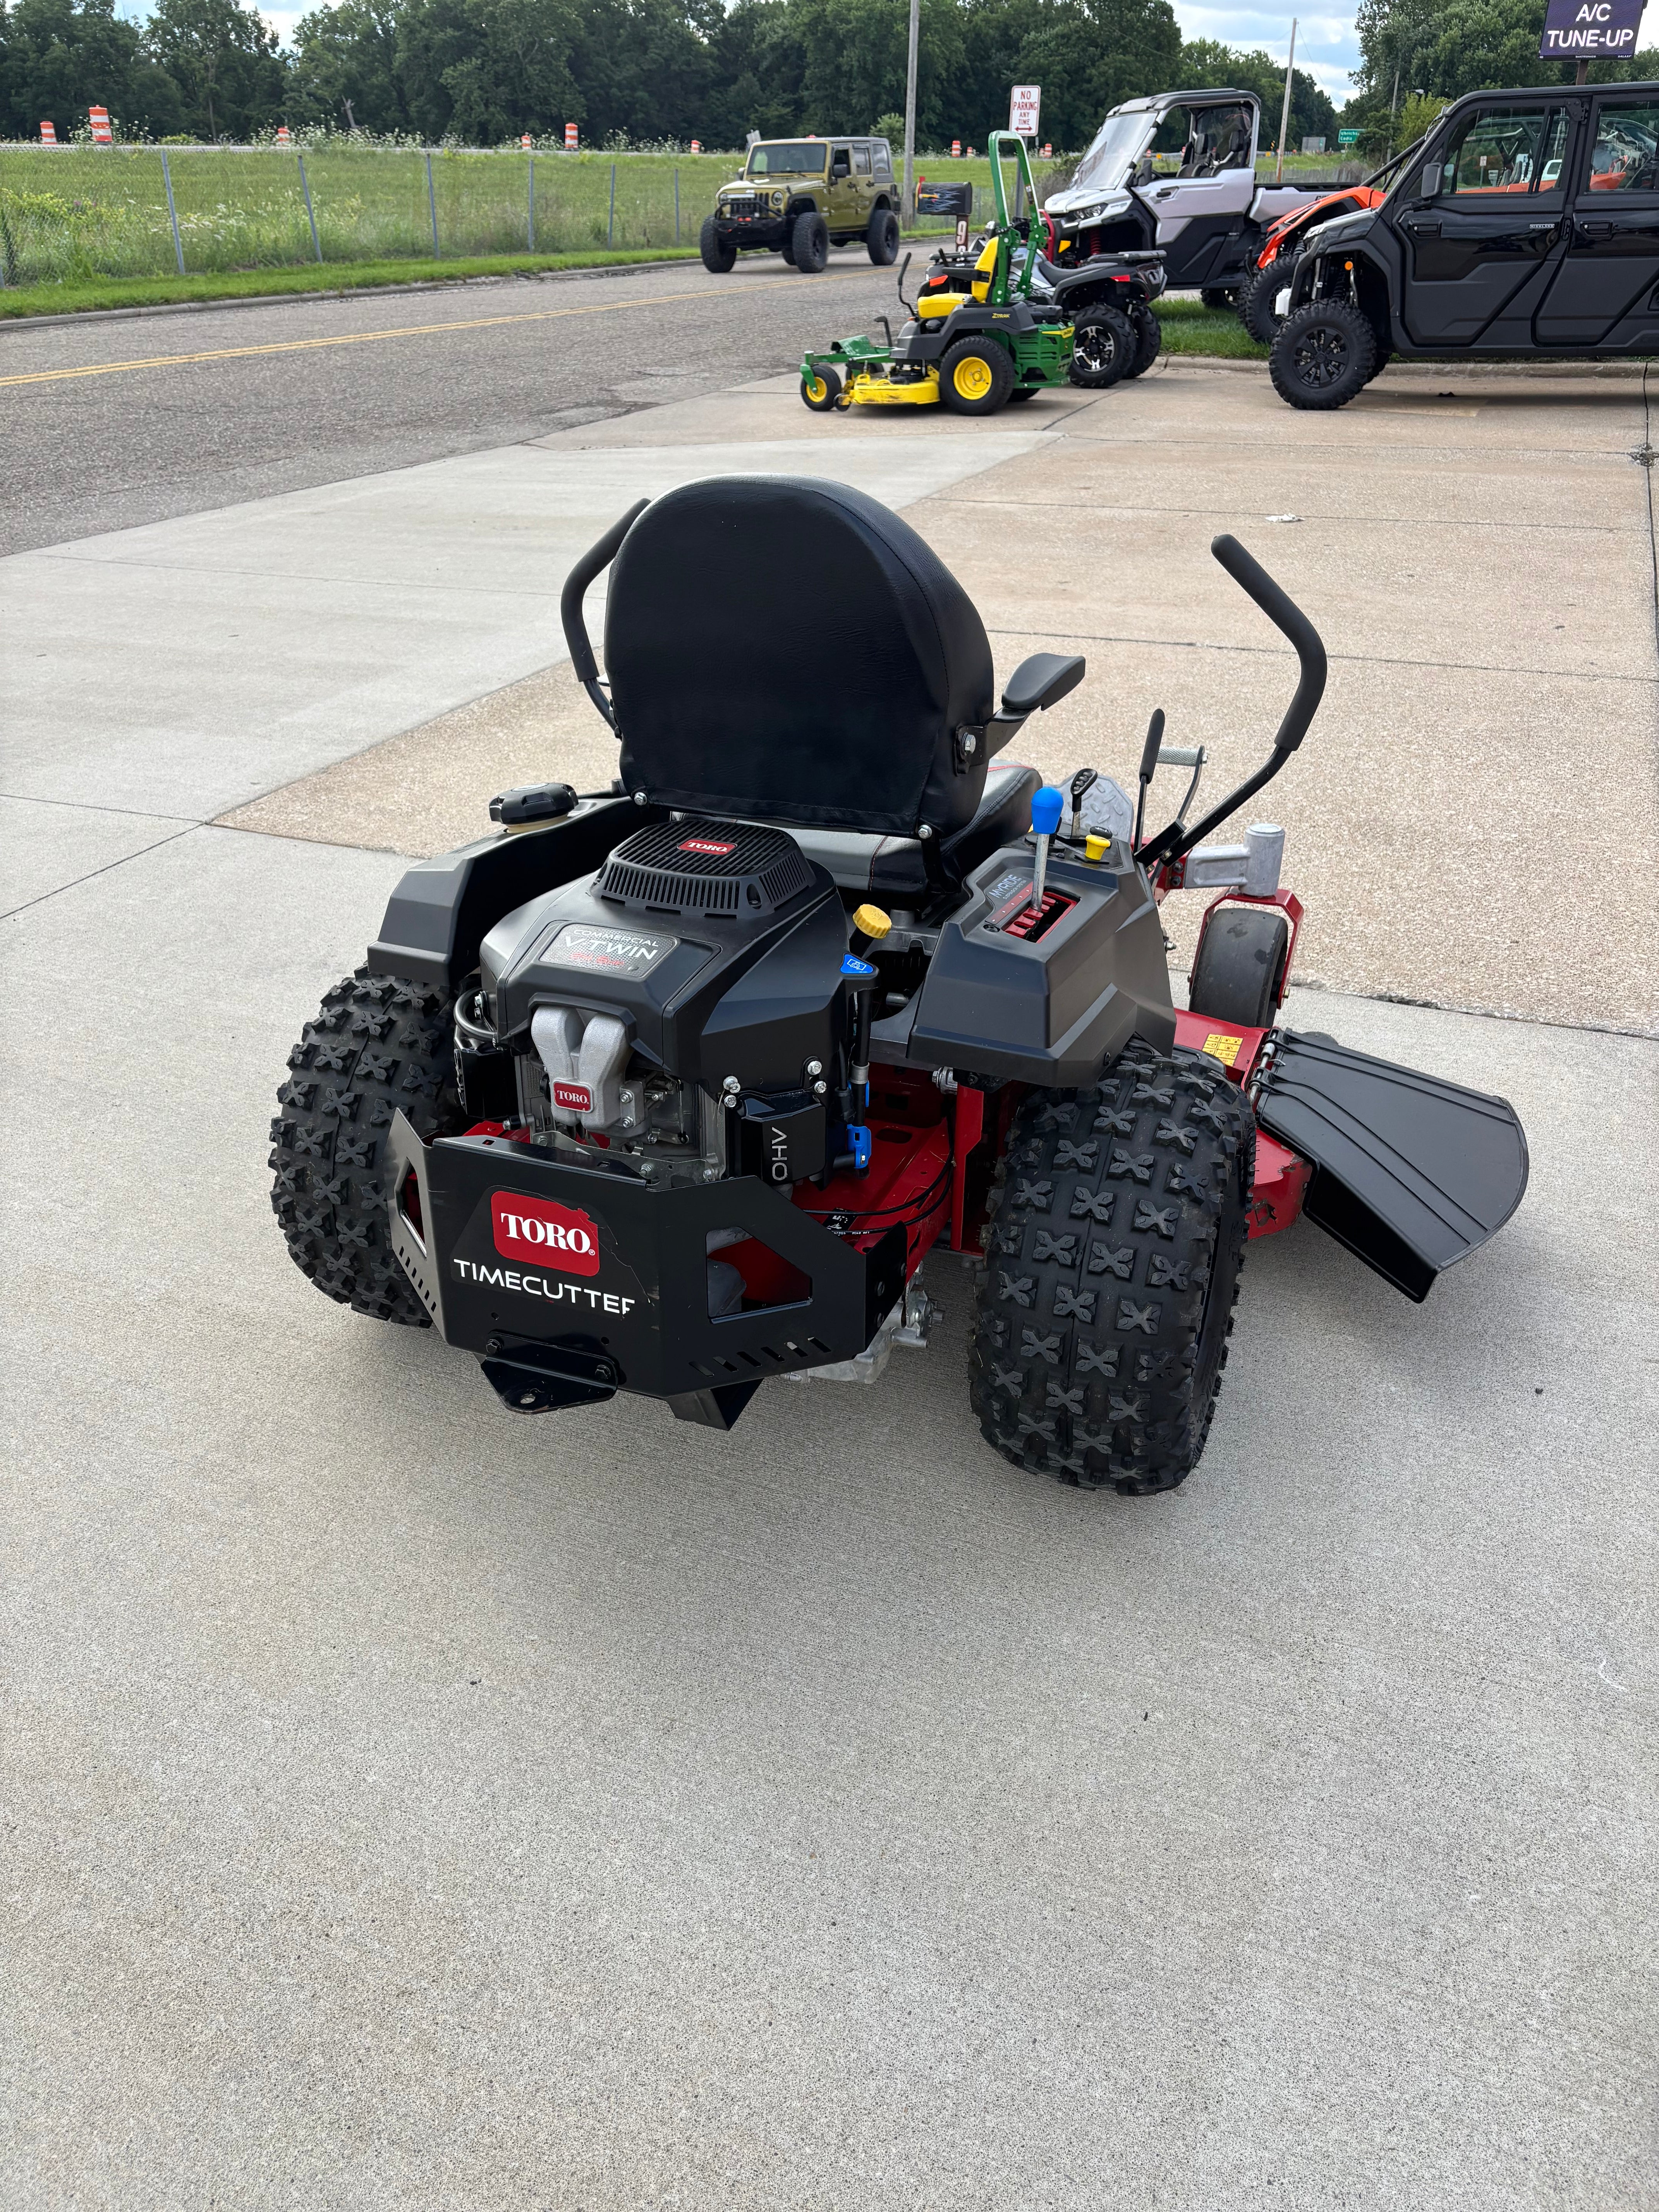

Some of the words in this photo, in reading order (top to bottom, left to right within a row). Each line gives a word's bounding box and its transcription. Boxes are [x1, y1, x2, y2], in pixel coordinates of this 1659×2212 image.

[1575, 3, 1611, 22] A/C
[1547, 29, 1633, 47] TUNE-UP
[1020, 90, 1031, 100] NO
[1013, 101, 1037, 110] PARKING
[687, 842, 728, 852] TORO
[573, 929, 659, 947] COMMERCIAL
[557, 1090, 588, 1104] TORO
[772, 1127, 787, 1181] OHV
